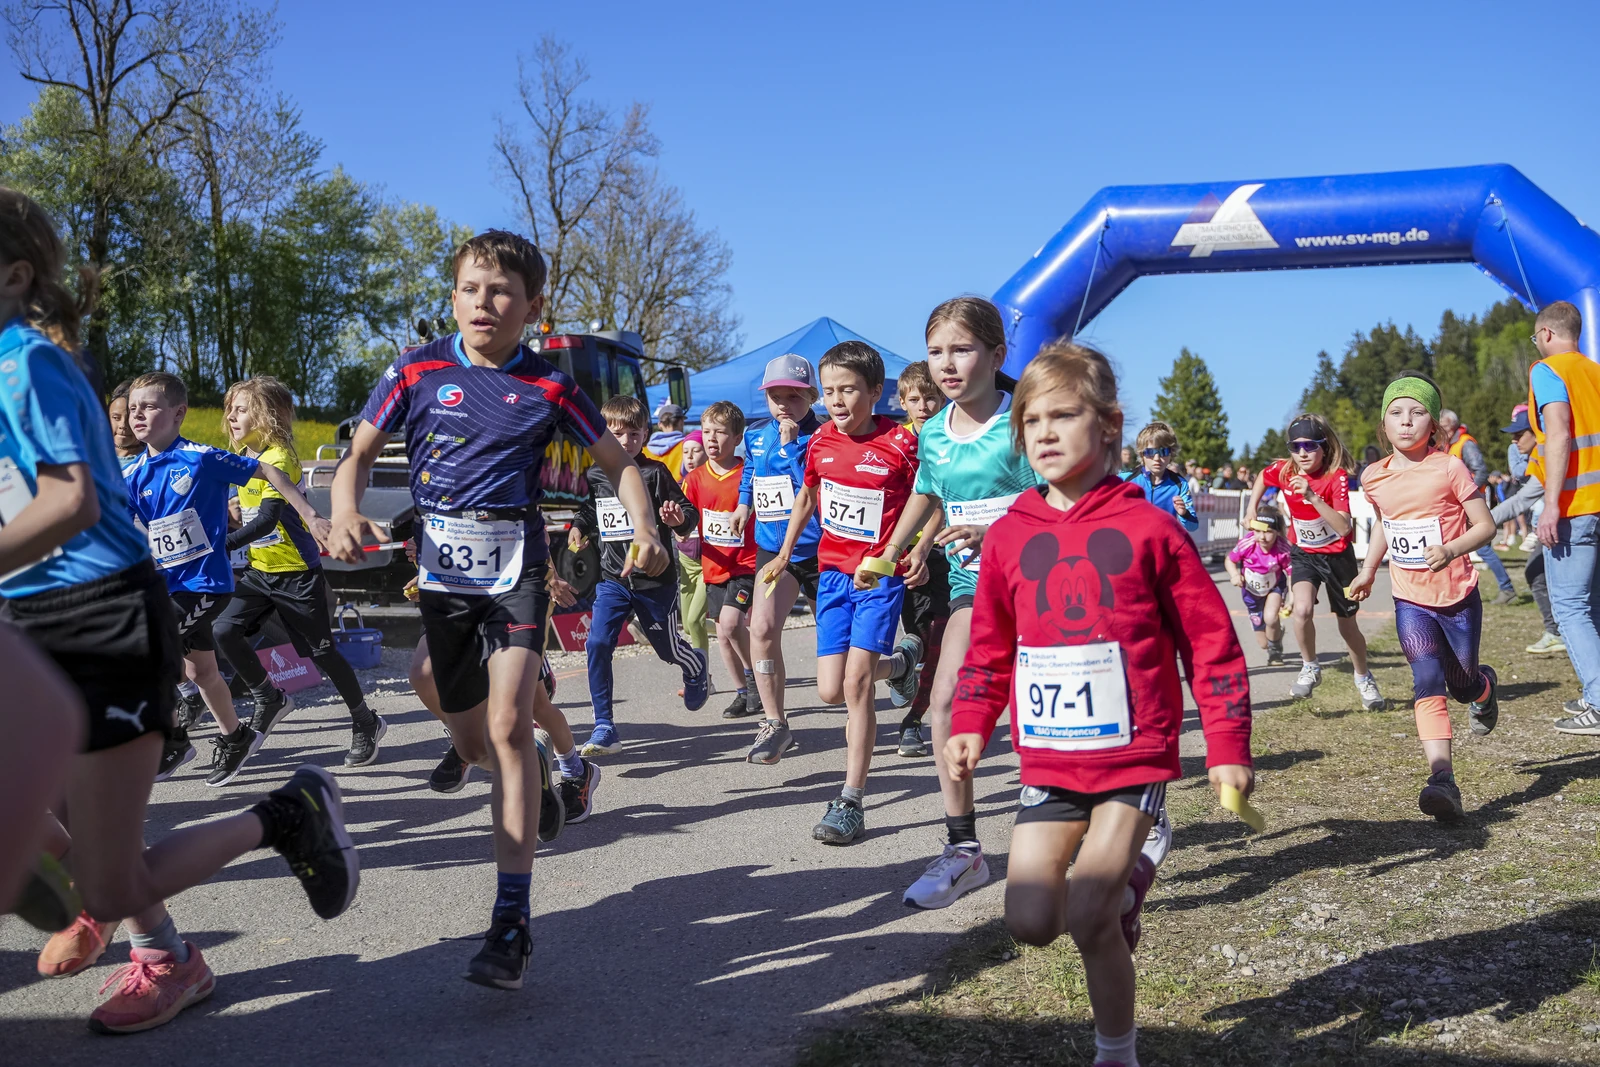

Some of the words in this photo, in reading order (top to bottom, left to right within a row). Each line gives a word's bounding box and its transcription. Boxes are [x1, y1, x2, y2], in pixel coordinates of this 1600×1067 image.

[1294, 227, 1430, 247] www.sv-mg.de
[420, 498, 452, 511] Schriber
[757, 490, 784, 508] 53-1
[829, 500, 865, 525] 57-1
[965, 505, 1010, 516] Allgäu-Oberschwa
[447, 521, 475, 529] Volksbank
[602, 510, 630, 528] 62-1
[447, 528, 508, 536] Allgäu-Oberschwaben
[1300, 526, 1329, 540] 89-1
[153, 528, 193, 554] 78-1
[1391, 535, 1427, 554] 49-1
[438, 543, 502, 572] 83-1
[440, 575, 459, 583] VBAO
[460, 576, 498, 586] Voralpencu
[1249, 580, 1270, 590] 48-1
[570, 630, 589, 640] Posc
[1029, 681, 1094, 718] 97-1
[1049, 727, 1101, 738] Voralpencup
